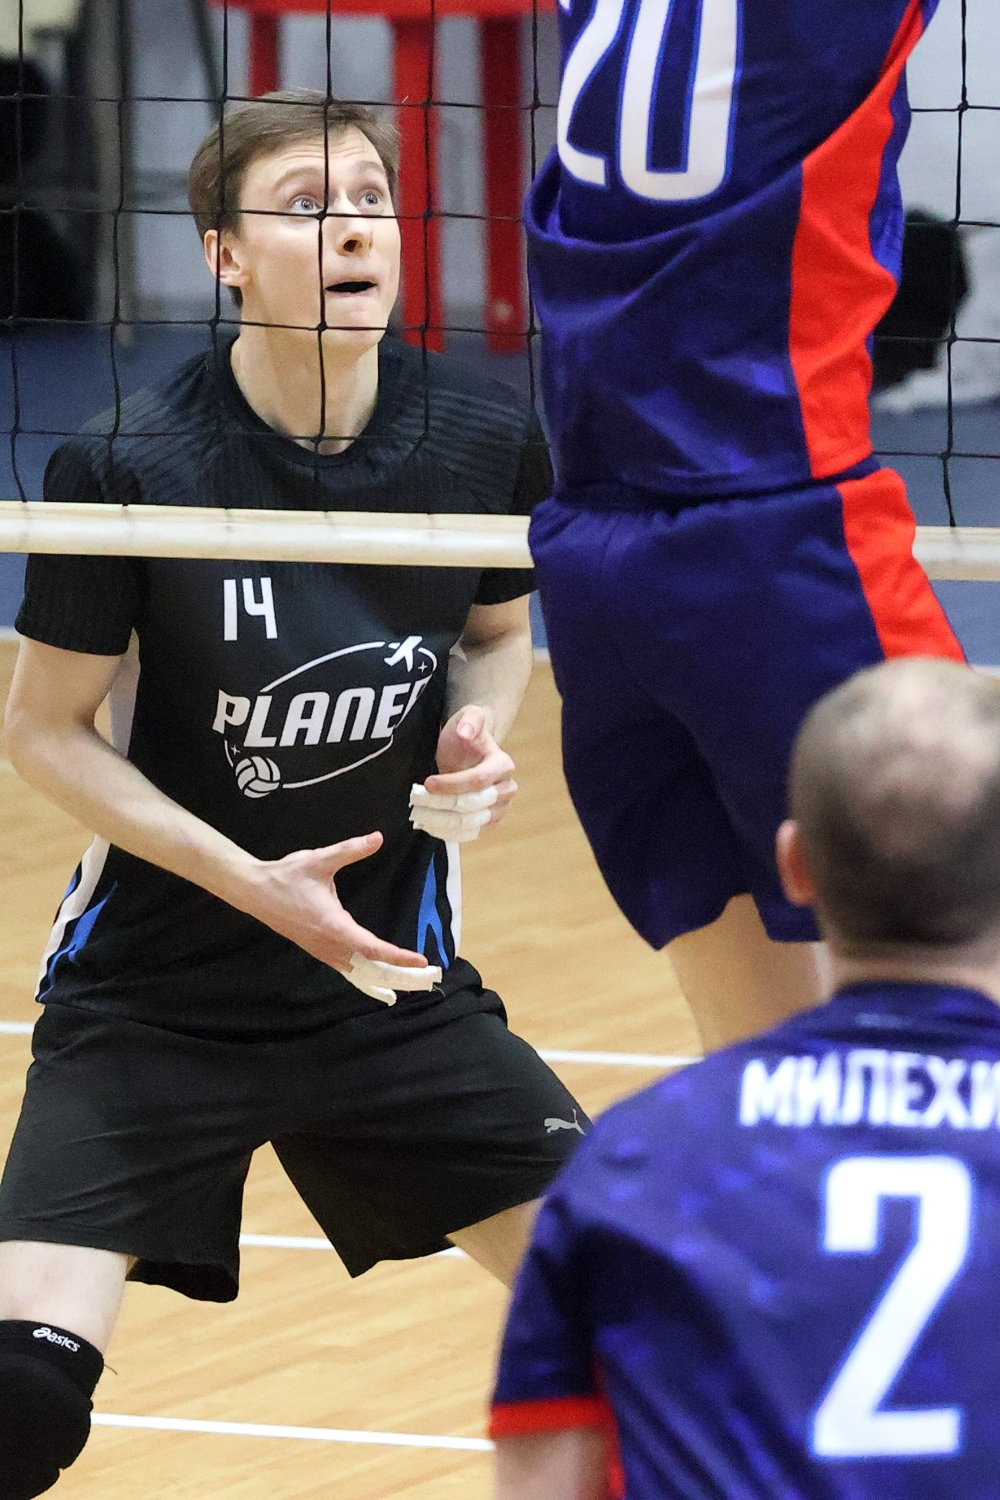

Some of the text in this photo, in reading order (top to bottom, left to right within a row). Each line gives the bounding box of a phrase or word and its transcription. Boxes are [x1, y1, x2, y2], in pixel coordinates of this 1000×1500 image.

[223, 576, 278, 641] 14
[812, 1154, 972, 1459] 2
[46, 1330, 80, 1352] asics
